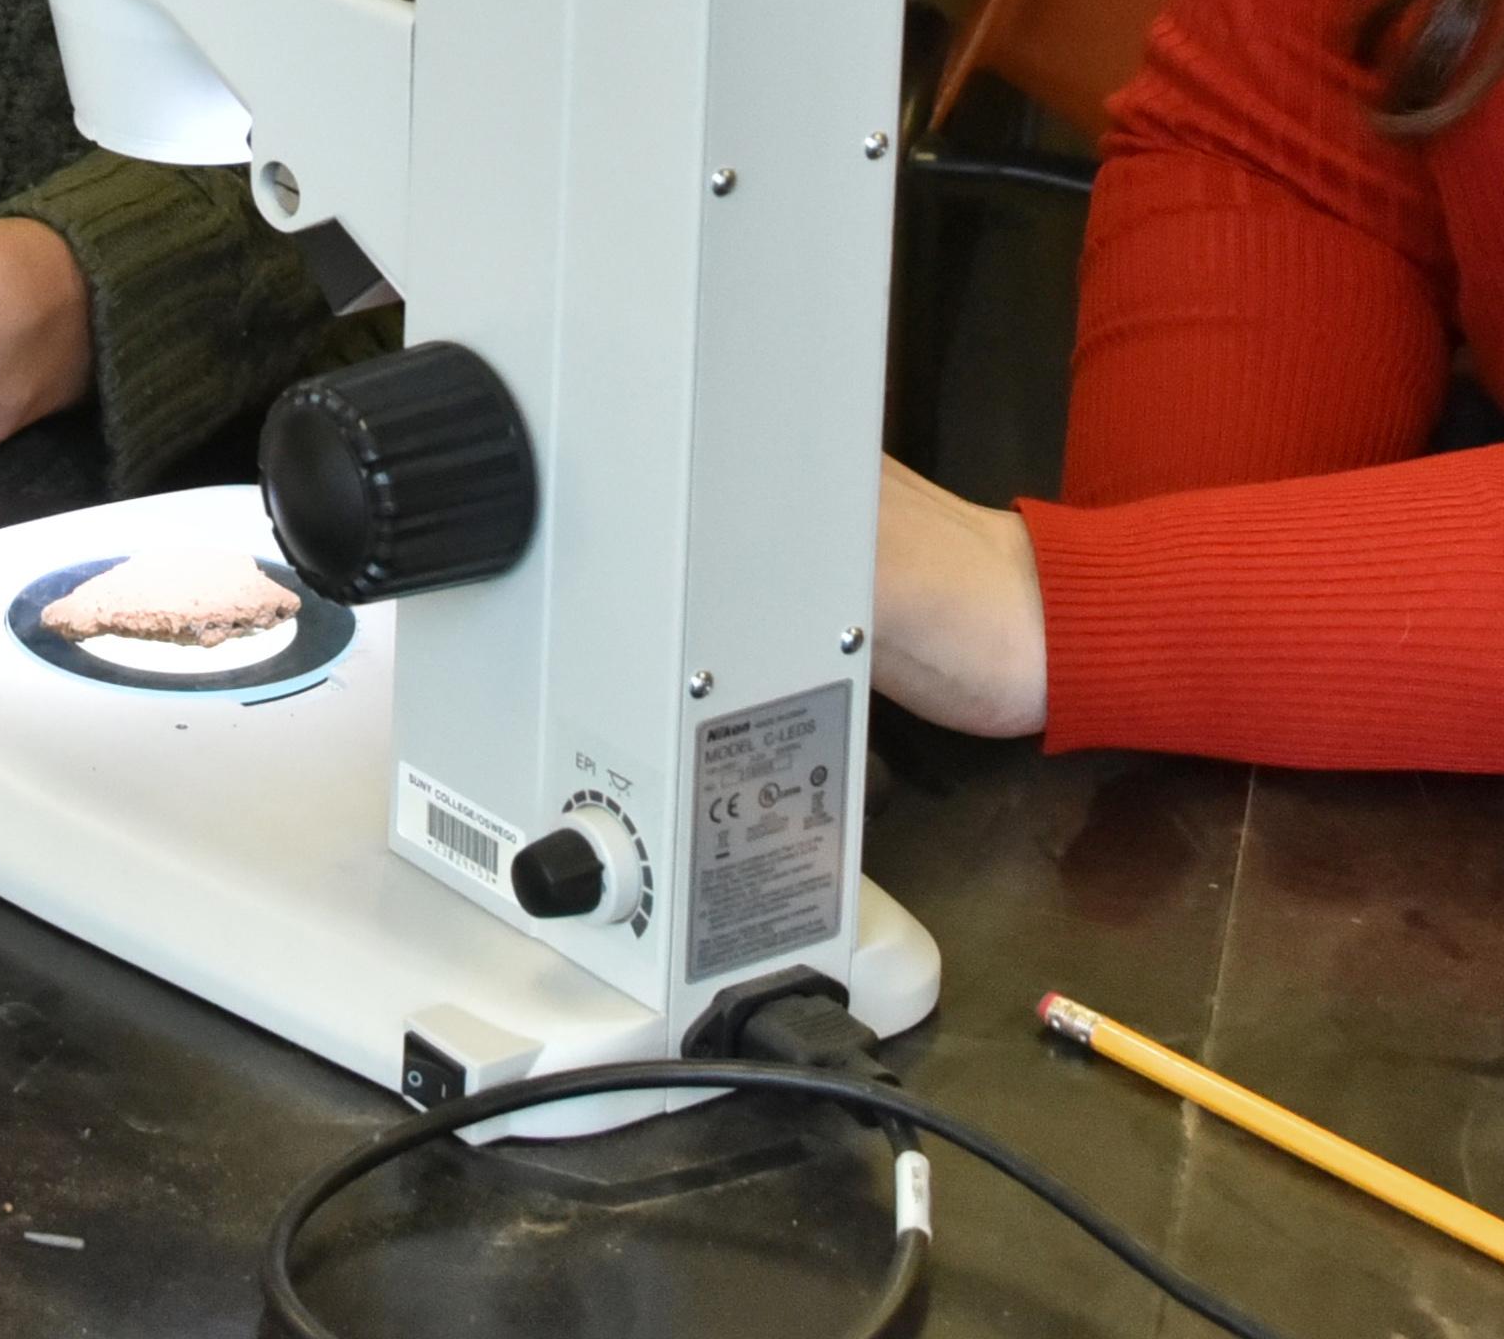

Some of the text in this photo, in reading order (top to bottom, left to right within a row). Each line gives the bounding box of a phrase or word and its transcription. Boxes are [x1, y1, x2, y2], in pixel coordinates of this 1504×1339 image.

[707, 721, 751, 743] Nikon
[705, 738, 754, 764] MODEL
[575, 752, 597, 776] EPI
[408, 773, 518, 844] SUNY COLLEGE/OSWEGO
